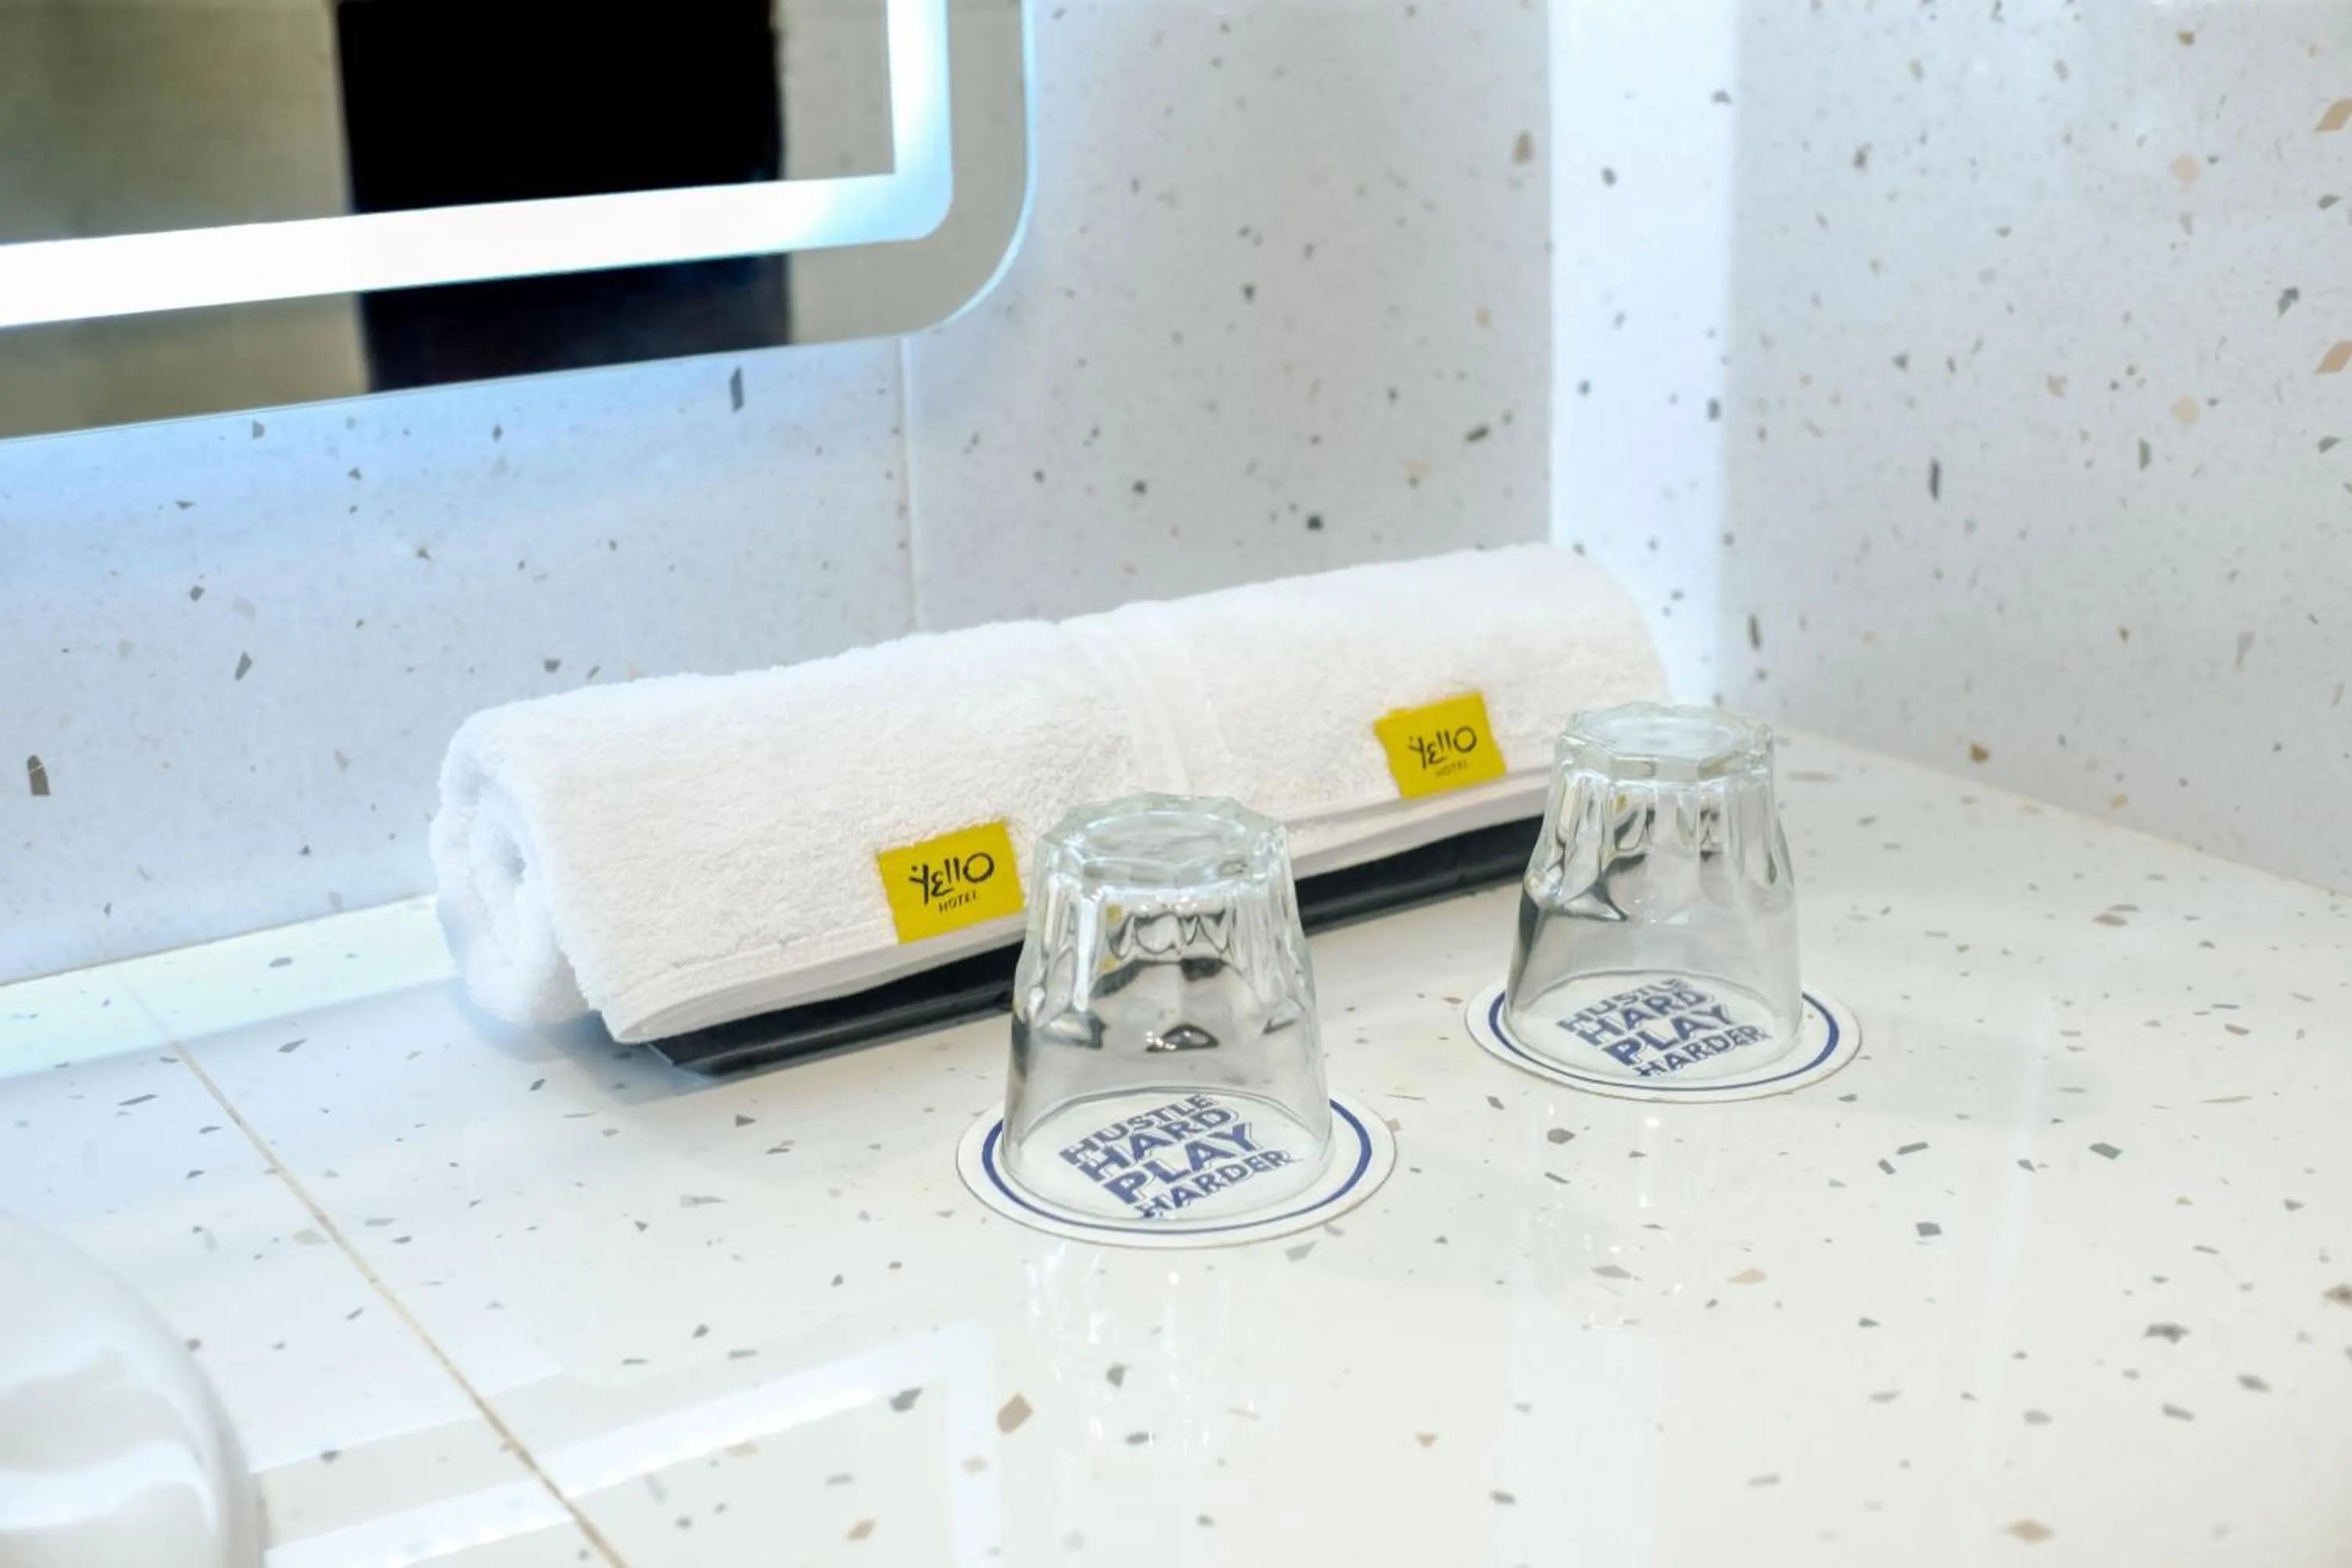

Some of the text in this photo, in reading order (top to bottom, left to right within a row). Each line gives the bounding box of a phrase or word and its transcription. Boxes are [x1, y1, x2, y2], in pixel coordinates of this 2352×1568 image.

[1555, 978, 1690, 1033] HUSTLE
[1575, 989, 1715, 1047] HARD
[1602, 1003, 1734, 1067] PLAY
[1632, 1025, 1774, 1078] HARDER
[1058, 1093, 1220, 1165] HUSTLE
[1077, 1106, 1240, 1181] HARD
[1102, 1122, 1264, 1205] PLAY
[1134, 1149, 1296, 1220] HARDER
